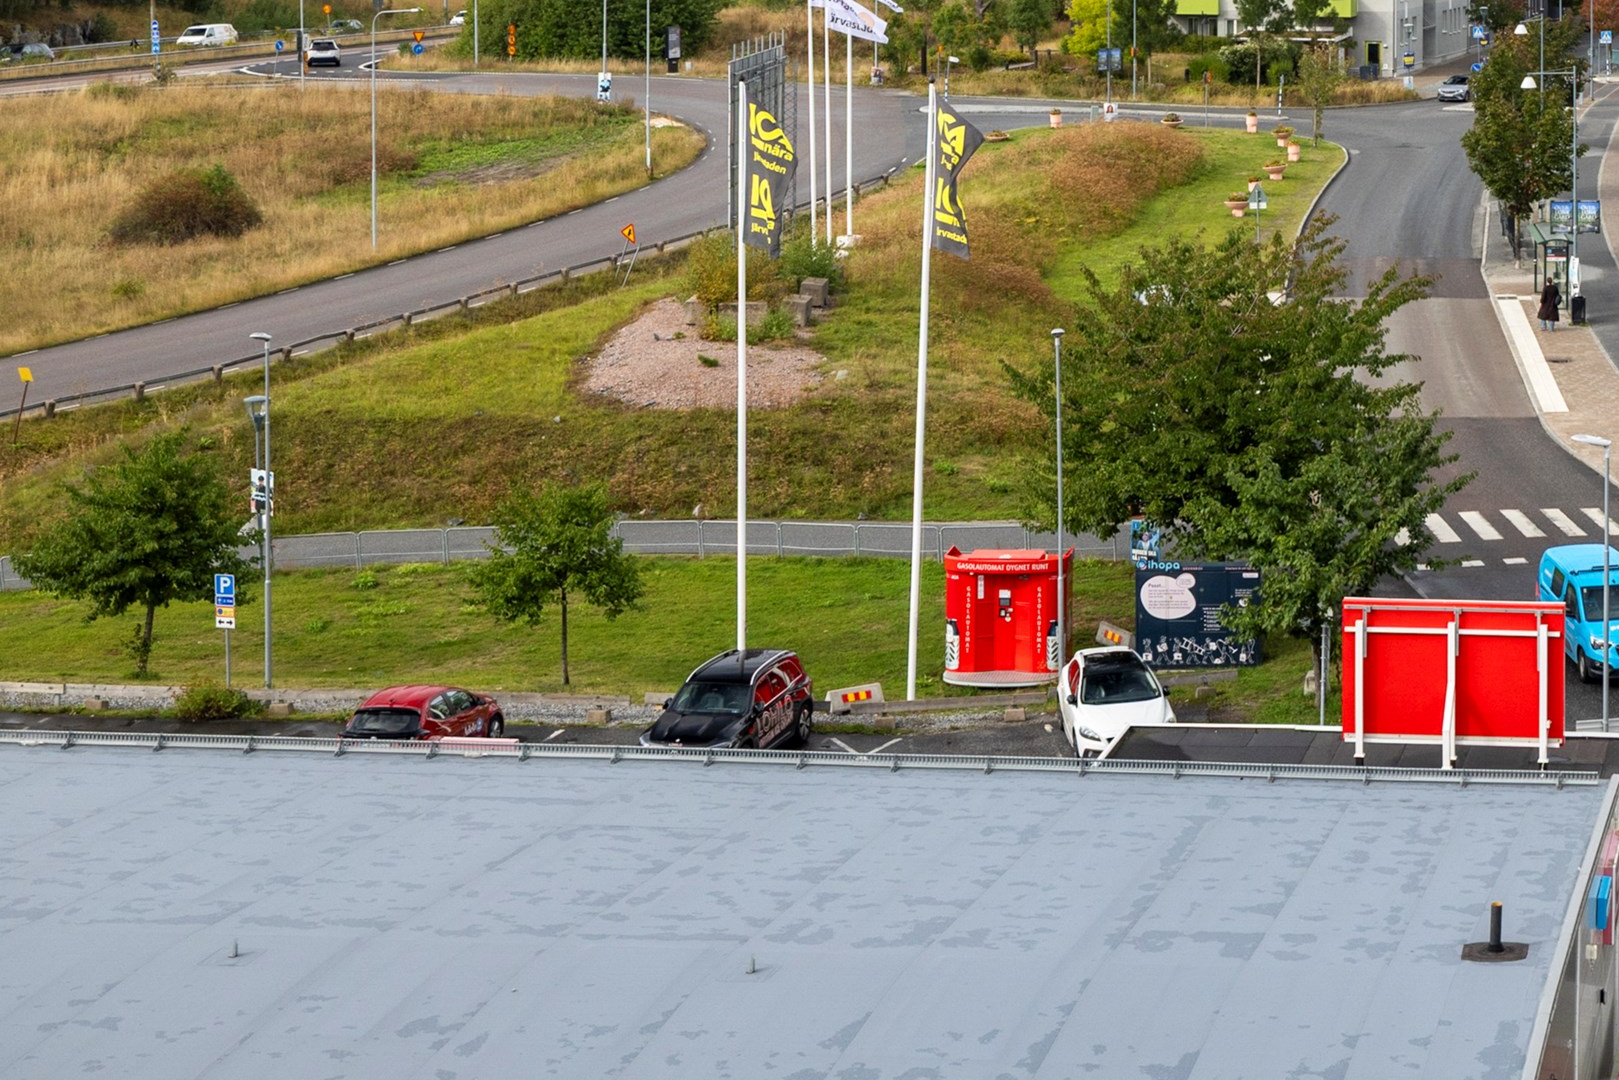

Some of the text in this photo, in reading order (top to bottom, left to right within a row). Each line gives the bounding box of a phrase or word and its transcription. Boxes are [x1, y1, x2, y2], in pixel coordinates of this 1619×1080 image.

[763, 143, 793, 162] nära
[957, 562, 1049, 571] GASOLAUTOMAT DYGNET RUNT
[220, 576, 231, 593] P
[756, 694, 793, 738] LOHILO
